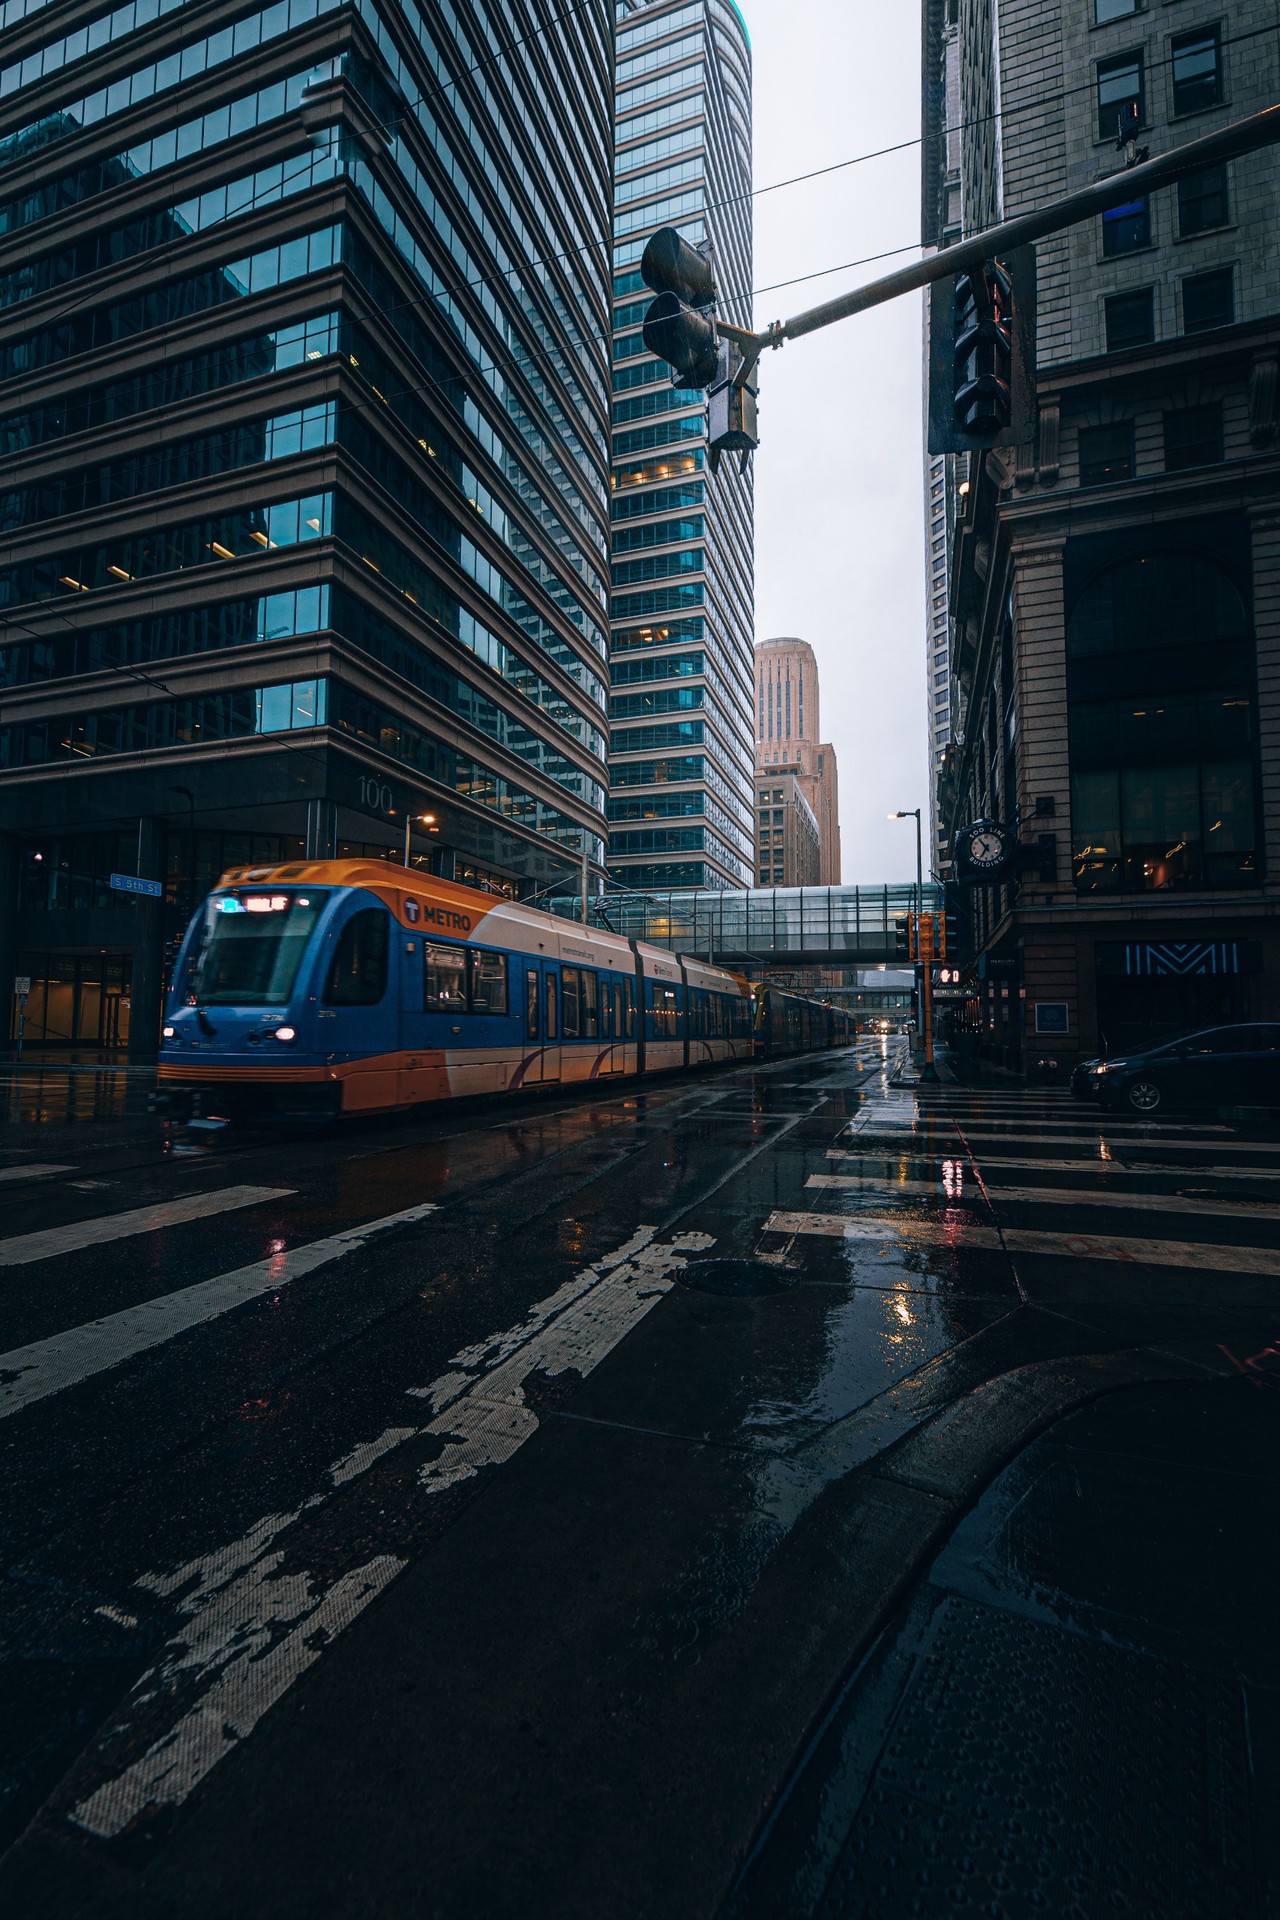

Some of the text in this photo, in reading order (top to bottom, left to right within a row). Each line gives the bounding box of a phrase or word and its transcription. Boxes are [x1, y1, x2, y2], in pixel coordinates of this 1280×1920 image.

[357, 776, 393, 816] 100
[969, 827, 1006, 839] SOO LINE
[969, 856, 1004, 868] BUILDING
[115, 878, 159, 893] S 5th St
[424, 905, 471, 931] METRO
